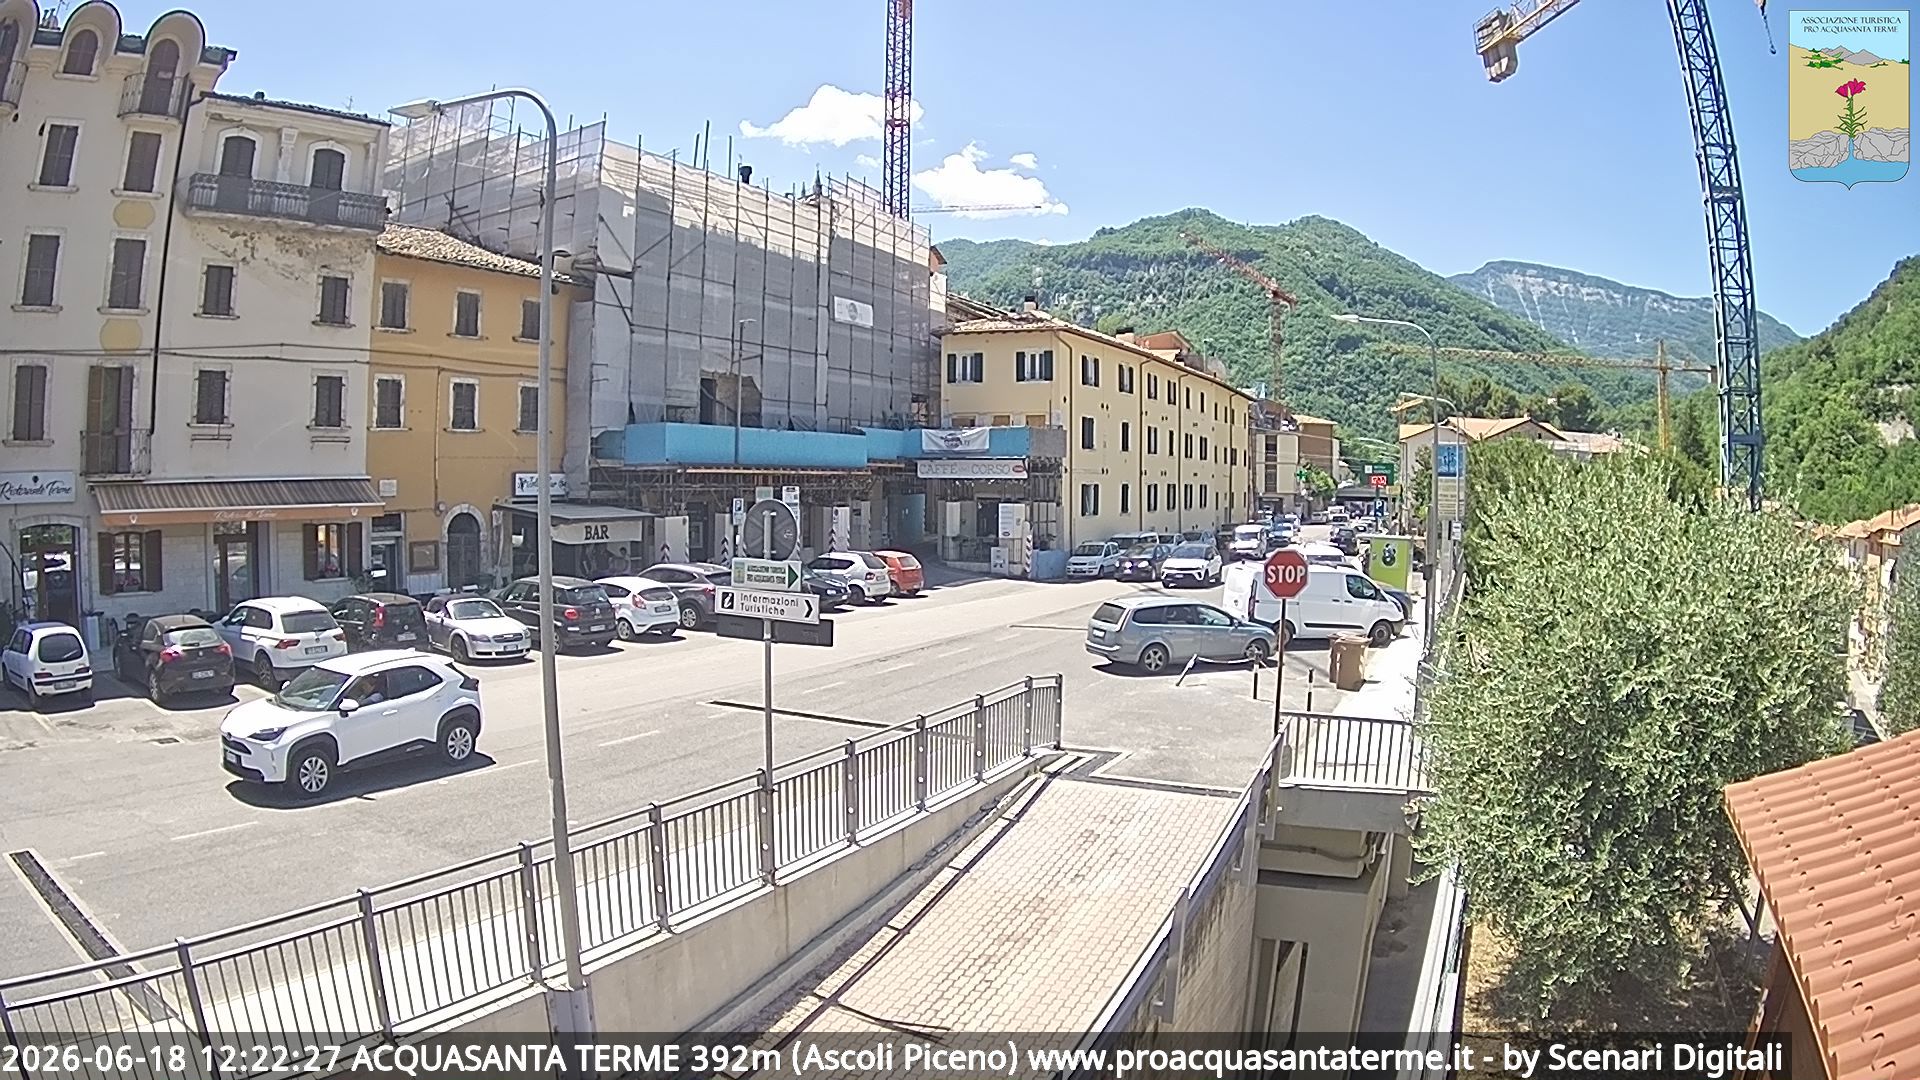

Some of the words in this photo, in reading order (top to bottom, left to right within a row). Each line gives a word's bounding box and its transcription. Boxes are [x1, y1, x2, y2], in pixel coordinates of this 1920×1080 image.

[971, 464, 1010, 475] CORSO
[584, 523, 610, 541] BAR
[1267, 565, 1306, 584] STOP
[741, 593, 799, 607] Informazioni
[741, 603, 785, 616] Turistiche
